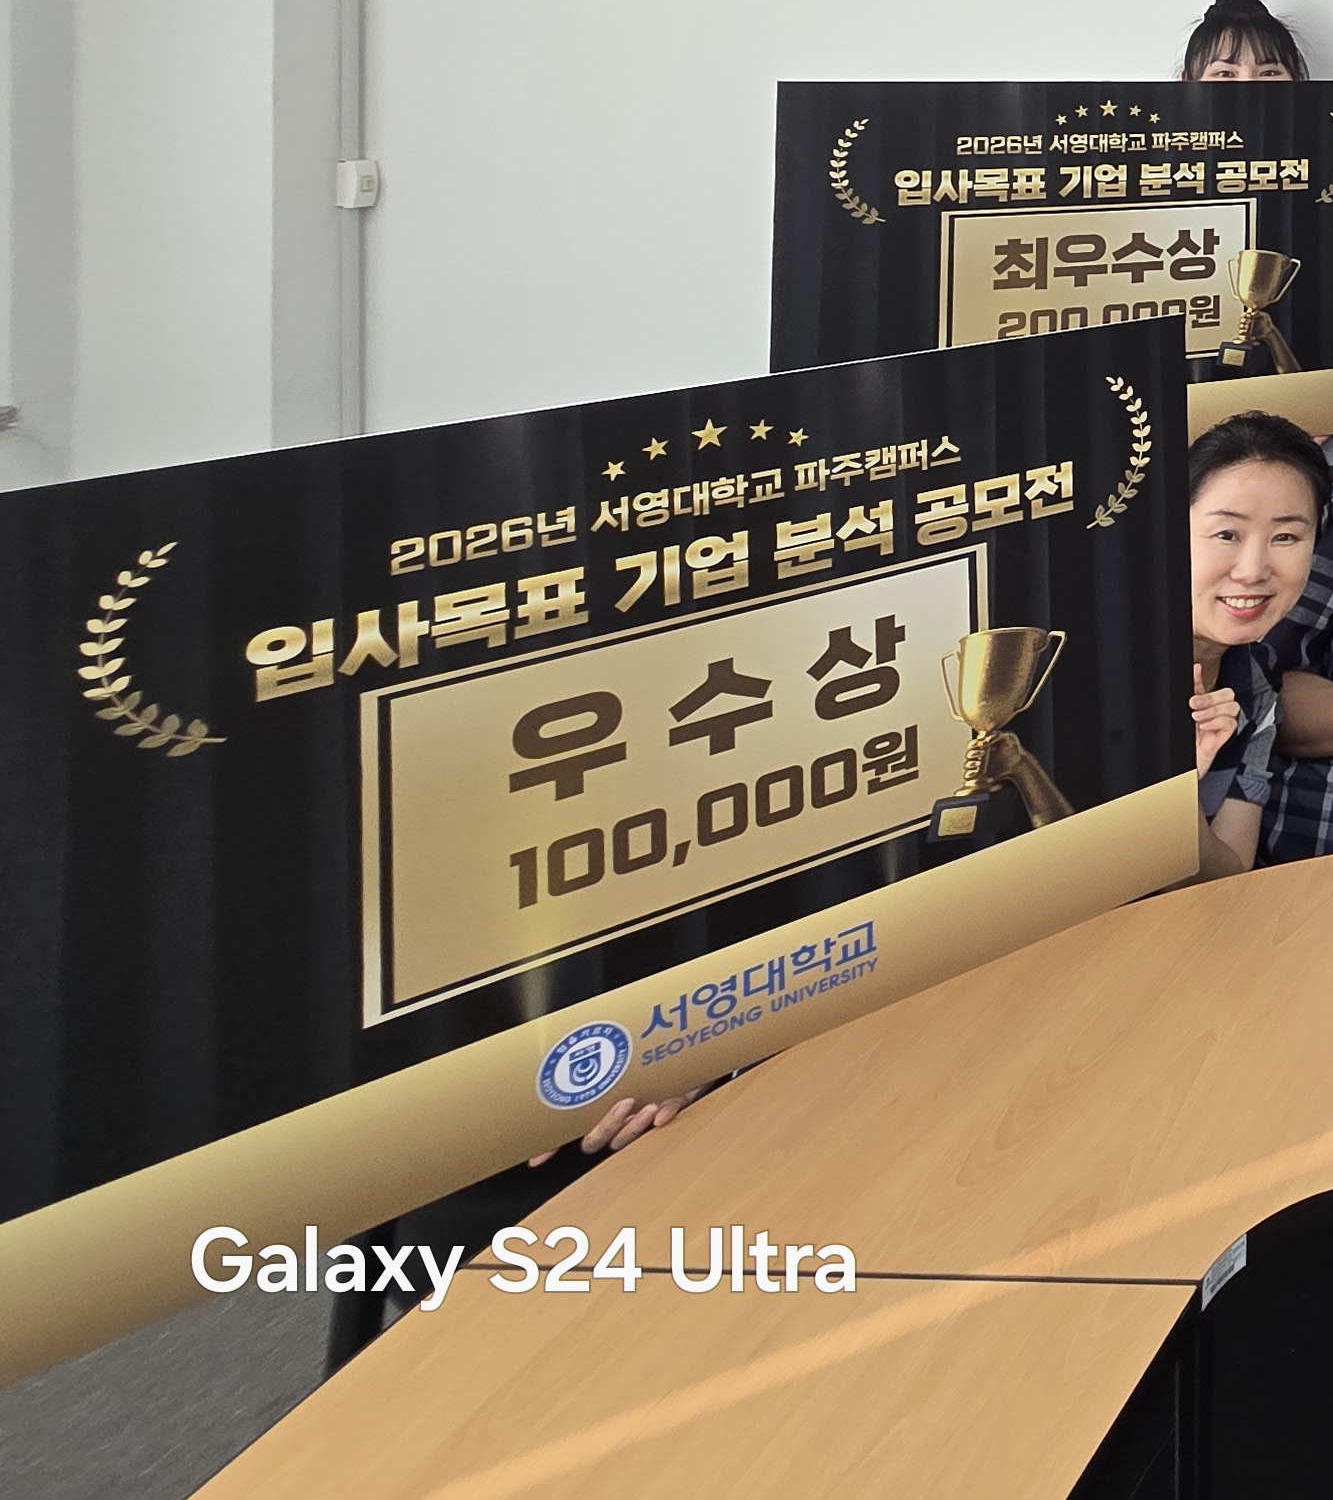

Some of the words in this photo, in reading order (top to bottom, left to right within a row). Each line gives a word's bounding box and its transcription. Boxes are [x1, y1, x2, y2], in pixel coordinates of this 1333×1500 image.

[894, 167, 1046, 206] 입사목표
[1058, 164, 1127, 199] 기업
[1139, 162, 1205, 196] 분석
[1215, 158, 1309, 194] 공모전
[956, 134, 1043, 156] 2026년
[1049, 133, 1147, 154] 서영대학교
[1151, 131, 1244, 151] 파주캠퍼스
[993, 228, 1220, 290] 최우수상
[390, 506, 577, 576] 2026년
[590, 468, 785, 533] 서영대학교
[794, 435, 962, 493] 파주캠퍼스
[245, 566, 589, 703] 입사목표
[614, 530, 749, 614] 기업
[773, 499, 894, 580] 분석
[914, 461, 1075, 547] 공모전
[509, 724, 919, 910] 100,000원
[640, 920, 877, 1040] 서영대학교
[641, 1006, 763, 1067] SEOYEONG
[770, 957, 879, 1014] UNIVERSITY
